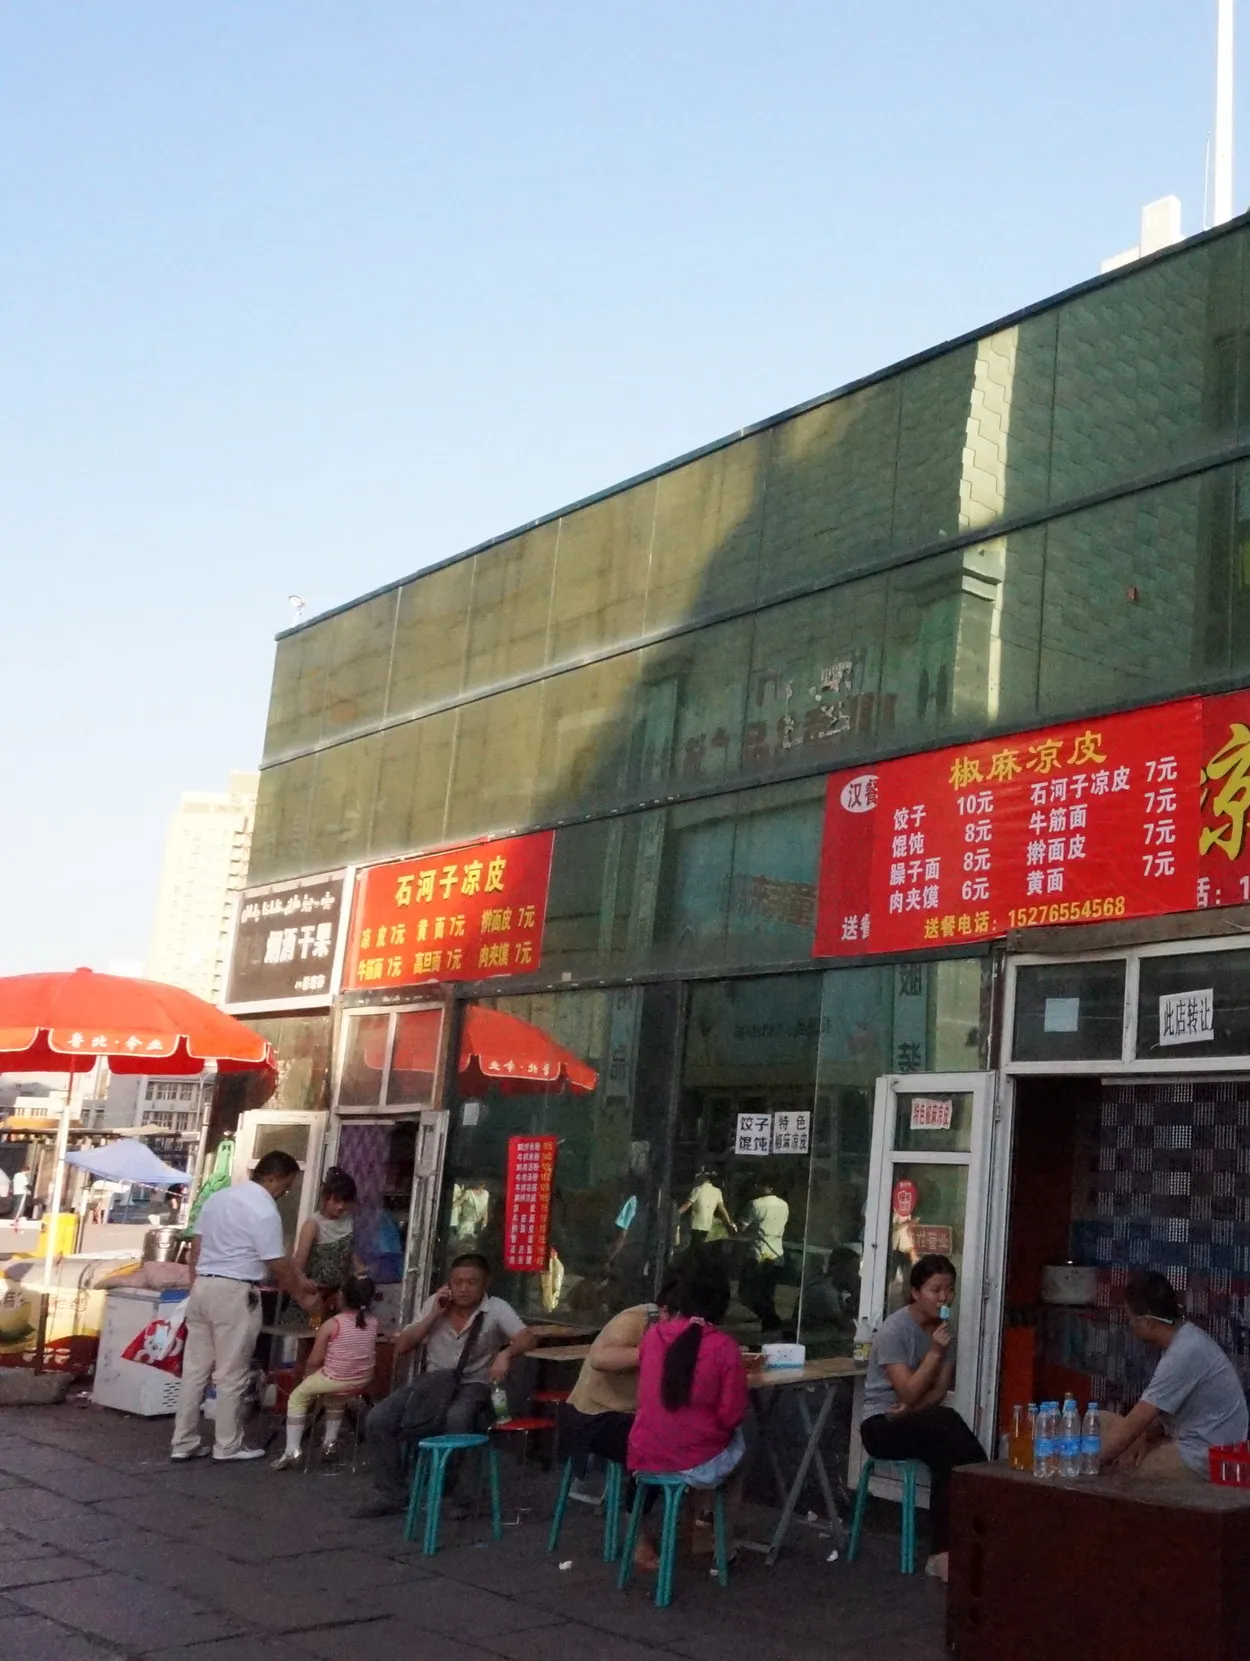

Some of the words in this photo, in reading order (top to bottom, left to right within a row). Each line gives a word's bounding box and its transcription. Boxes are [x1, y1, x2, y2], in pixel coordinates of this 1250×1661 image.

[949, 729, 1108, 792] 椒麻凉皮
[1030, 765, 1131, 806] 石河子凉皮
[1145, 755, 1178, 783] 7元
[893, 804, 927, 831] 饺子
[956, 790, 995, 817] 10元
[1028, 803, 1089, 836] 牛筋面
[1144, 787, 1177, 814] 7元
[892, 832, 925, 858] 馄饨
[964, 818, 993, 843] 8元
[1026, 833, 1087, 867] 擀面皮
[1142, 818, 1176, 846] 7元
[963, 847, 992, 872] 8元
[1026, 867, 1065, 897] 黄面
[1142, 850, 1176, 877] 7元
[394, 855, 508, 908] 石河子凉皮
[889, 884, 940, 914] 肉夹馍
[961, 876, 990, 901] 6元
[390, 923, 407, 946] 7元
[416, 916, 446, 942] 黄面
[449, 914, 467, 937] 7元
[518, 904, 536, 929] 7元
[1007, 896, 1126, 929] 15276554568
[386, 955, 403, 978] 7元
[447, 948, 463, 971] 7元
[515, 940, 533, 965] 7元
[1163, 996, 1214, 1038] 此店转让
[740, 1116, 769, 1132] 饺子
[778, 1115, 806, 1131] 特色
[739, 1136, 768, 1152] 馄饨
